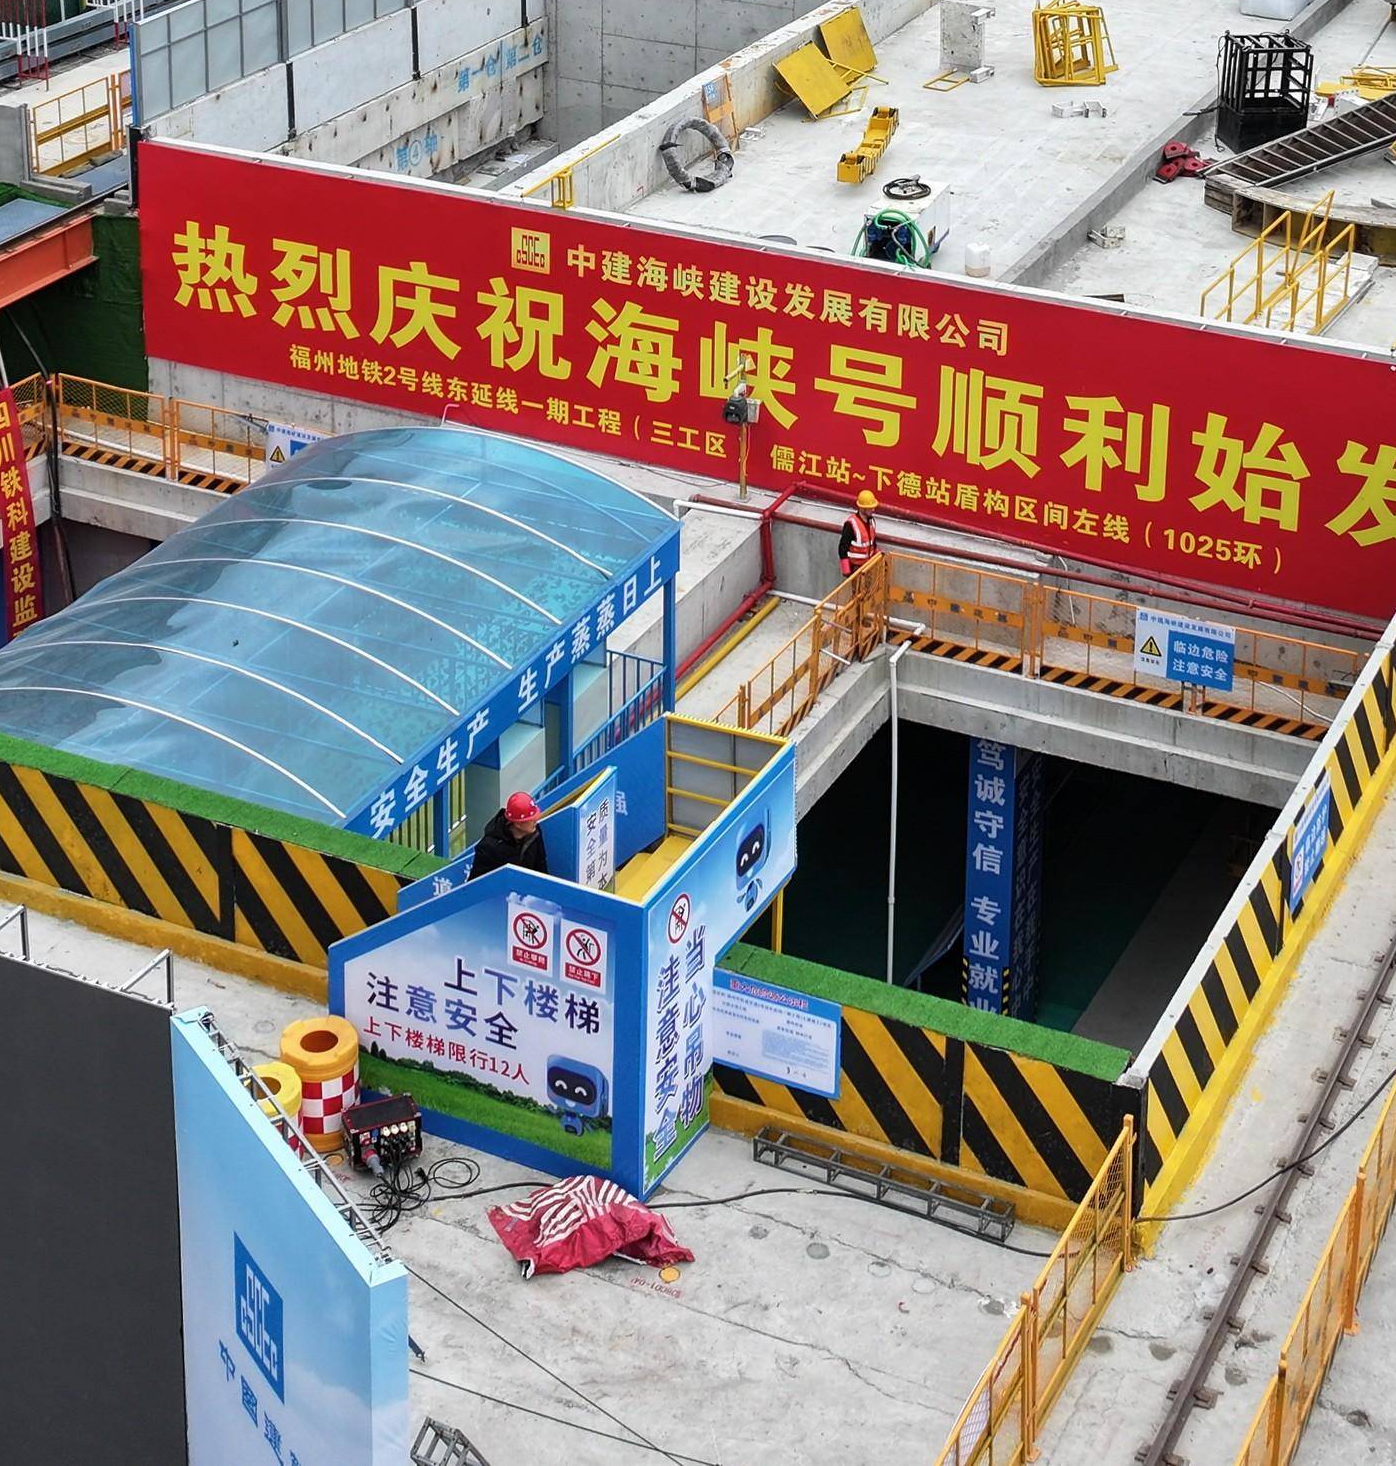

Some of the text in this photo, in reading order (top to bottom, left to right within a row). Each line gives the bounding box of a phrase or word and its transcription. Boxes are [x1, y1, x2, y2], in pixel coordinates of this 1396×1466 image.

[566, 243, 1009, 357] 中建海峡建设发展有限公司
[370, 555, 663, 839] 安全生产 生产蒸蒸日上
[1172, 658, 1227, 681] 注意安全
[1173, 640, 1229, 664] 临边危险
[598, 798, 610, 891] 质量为本
[971, 738, 1006, 875] 笃诚守信
[365, 970, 520, 1051] 注意安全
[444, 956, 601, 1035] 上下楼梯
[682, 925, 708, 1131] 当心吊物
[363, 1017, 531, 1087] 上下楼梯限行12人
[651, 953, 681, 1165] 注意安全
